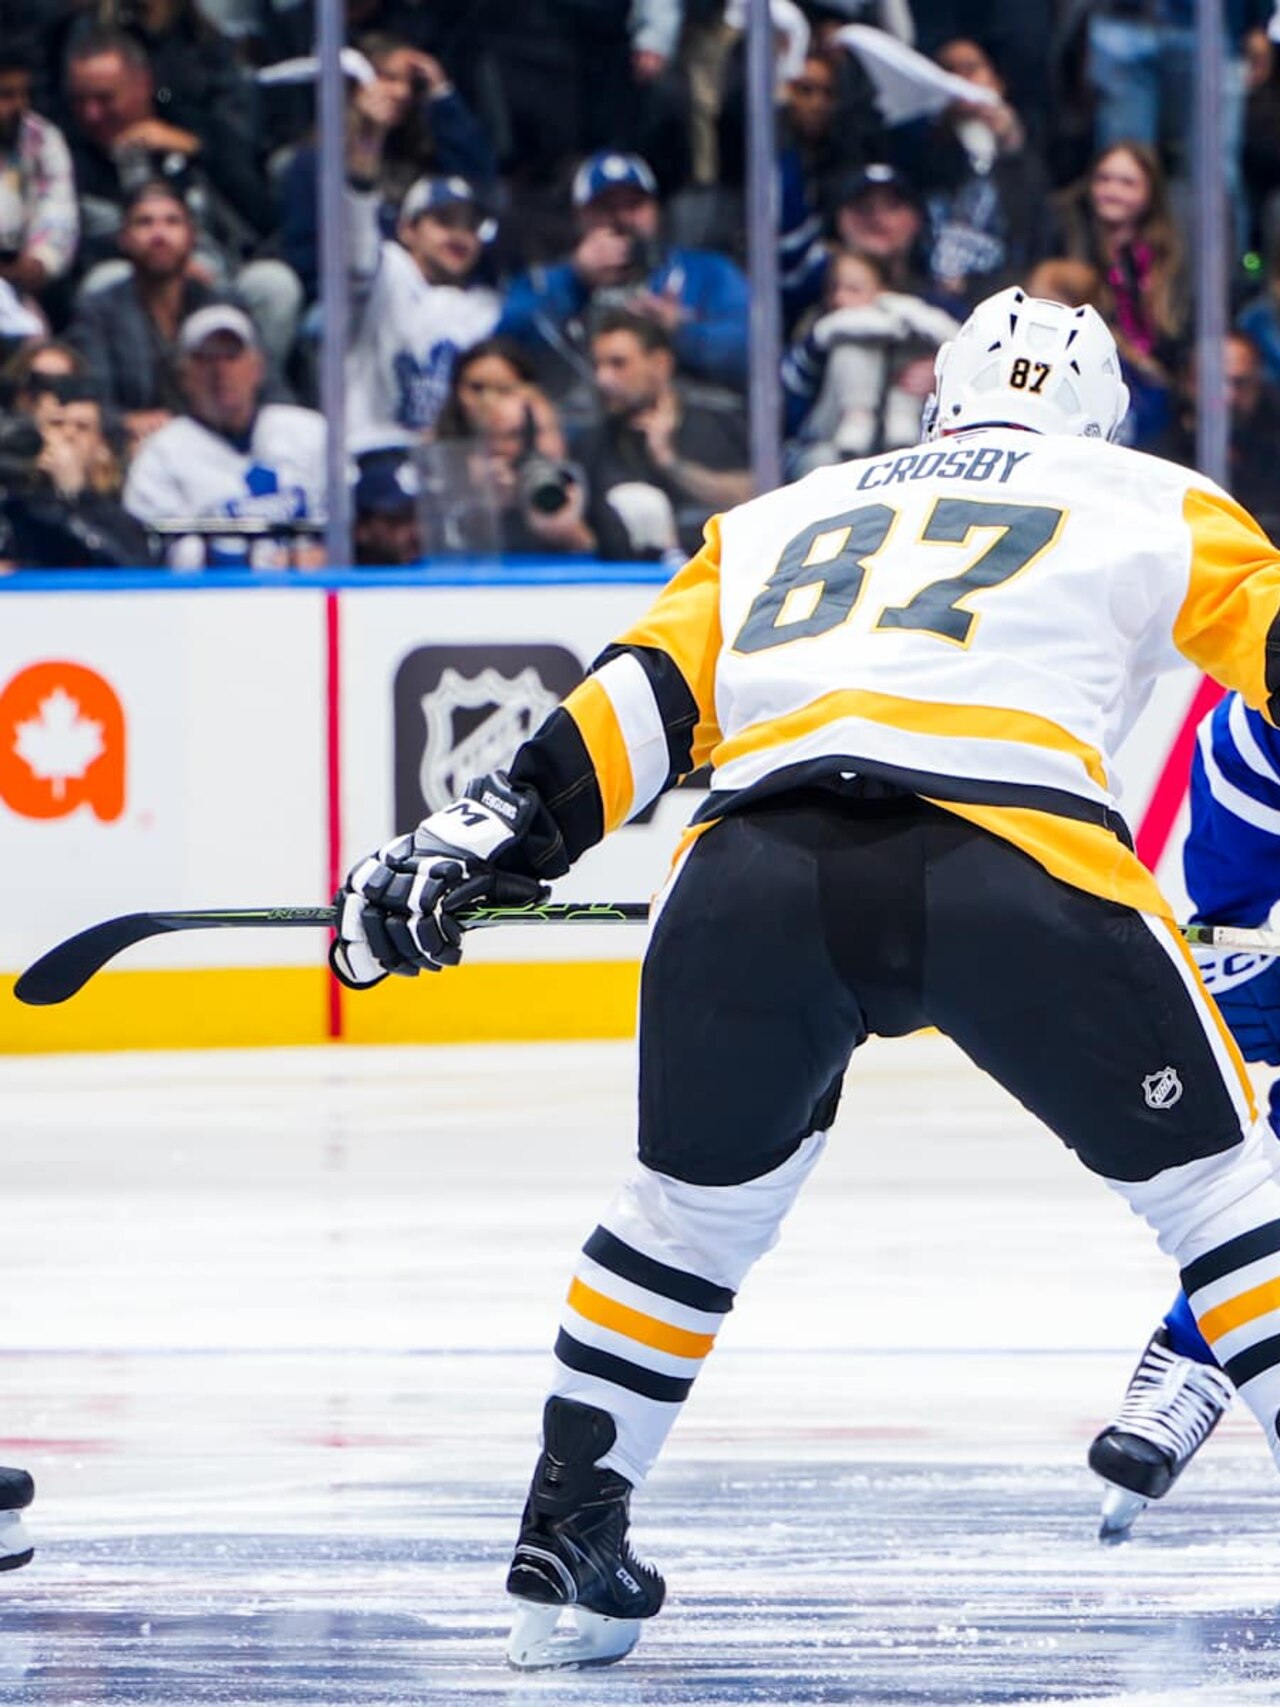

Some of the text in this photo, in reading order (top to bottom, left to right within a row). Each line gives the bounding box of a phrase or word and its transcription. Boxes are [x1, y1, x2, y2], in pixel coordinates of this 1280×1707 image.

[1008, 357, 1053, 395] 87
[855, 447, 1032, 490] CROSBY
[728, 496, 1071, 656] 87
[615, 1567, 642, 1594] CCM
